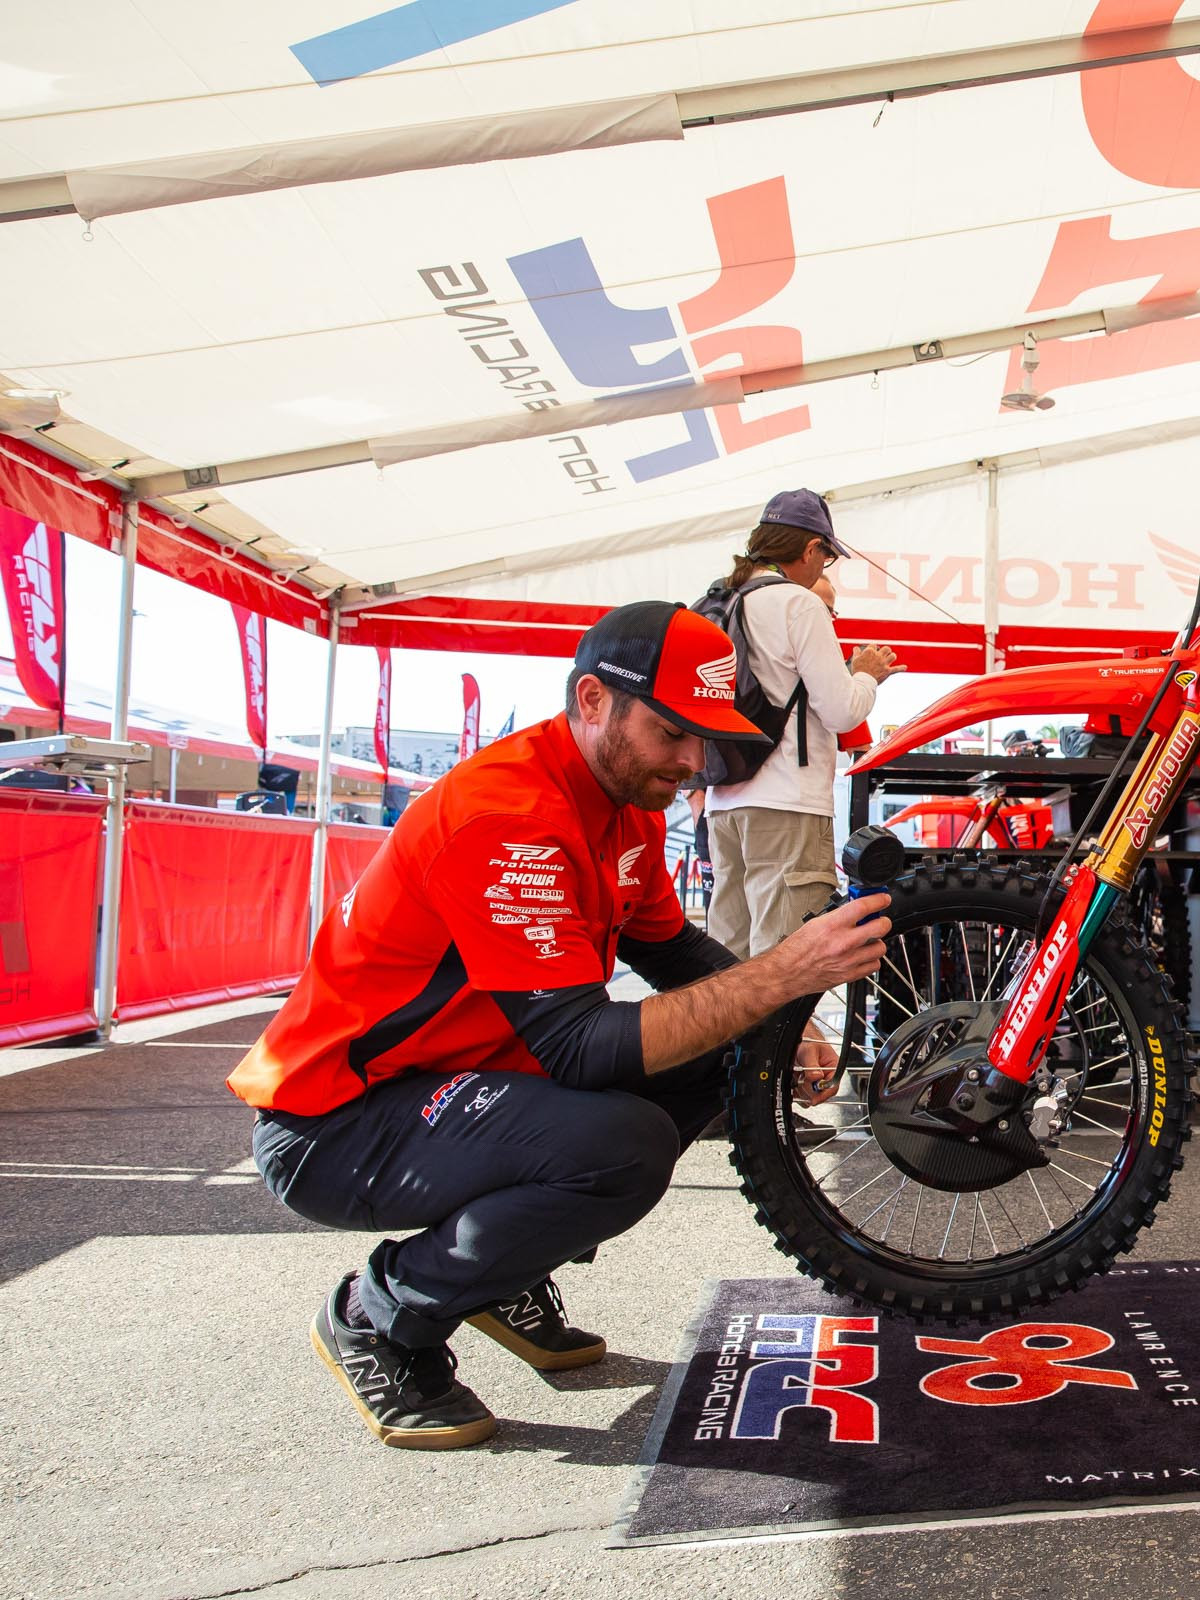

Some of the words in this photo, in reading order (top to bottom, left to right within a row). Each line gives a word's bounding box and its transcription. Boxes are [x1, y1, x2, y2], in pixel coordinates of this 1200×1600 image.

[12, 554, 36, 653] RACING
[597, 661, 644, 683] PROGRESSIVE
[1113, 667, 1165, 675] TRUETIMBER
[1143, 717, 1200, 815] SHOWA
[489, 859, 518, 868] Pro
[519, 861, 565, 872] Honda
[500, 872, 557, 887] SHOWA
[521, 889, 564, 897] HINSON
[492, 914, 516, 923] Twin
[527, 929, 552, 938] GET
[999, 919, 1068, 1059] DUNLOP
[1147, 1036, 1168, 1147] DUNLOP
[716, 1314, 754, 1368] Honda
[1123, 1311, 1199, 1407] LAWRENCE
[729, 1313, 880, 1444] HRC
[694, 1369, 738, 1441] RACING
[1045, 1466, 1200, 1484] MATRIX
